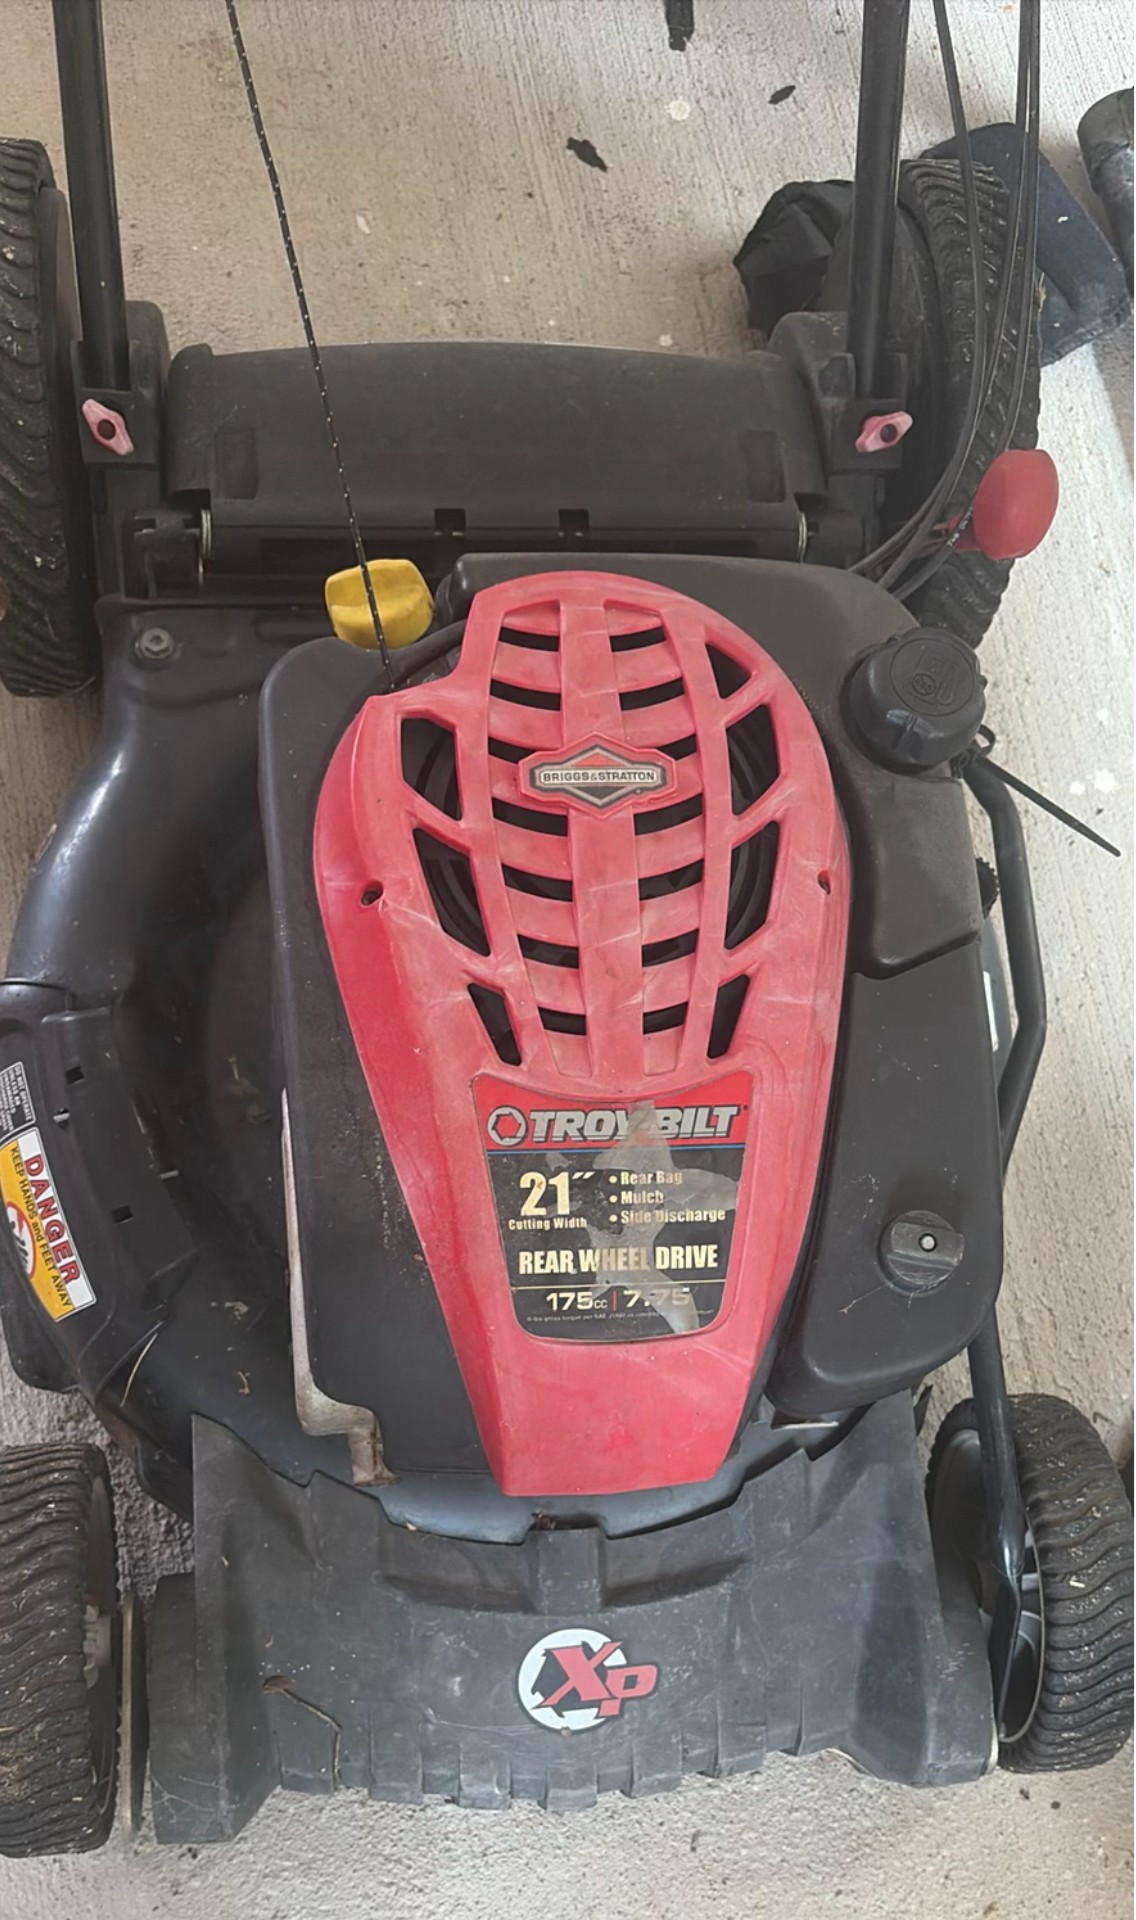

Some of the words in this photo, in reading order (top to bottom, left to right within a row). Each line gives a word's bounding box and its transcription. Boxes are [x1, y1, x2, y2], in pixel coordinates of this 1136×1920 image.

[543, 770, 656, 782] BRIGGS&STRATTON
[529, 1104, 739, 1144] TROYBILT
[620, 1172, 655, 1185] Rear
[656, 1170, 683, 1186] Bag
[621, 1190, 664, 1205] Mulch
[25, 1155, 82, 1286] DANGER
[508, 1218, 551, 1231] Cutting
[553, 1217, 588, 1230] Width
[621, 1210, 652, 1225] Side
[9, 1147, 25, 1178] KEEP
[18, 1179, 37, 1220] HANDS
[31, 1221, 45, 1243] and
[39, 1243, 57, 1273] FEET
[51, 1274, 73, 1308] AWAY
[519, 1251, 575, 1275] REAR
[579, 1248, 650, 1273] WHEEL
[655, 1244, 719, 1270] DRIVE
